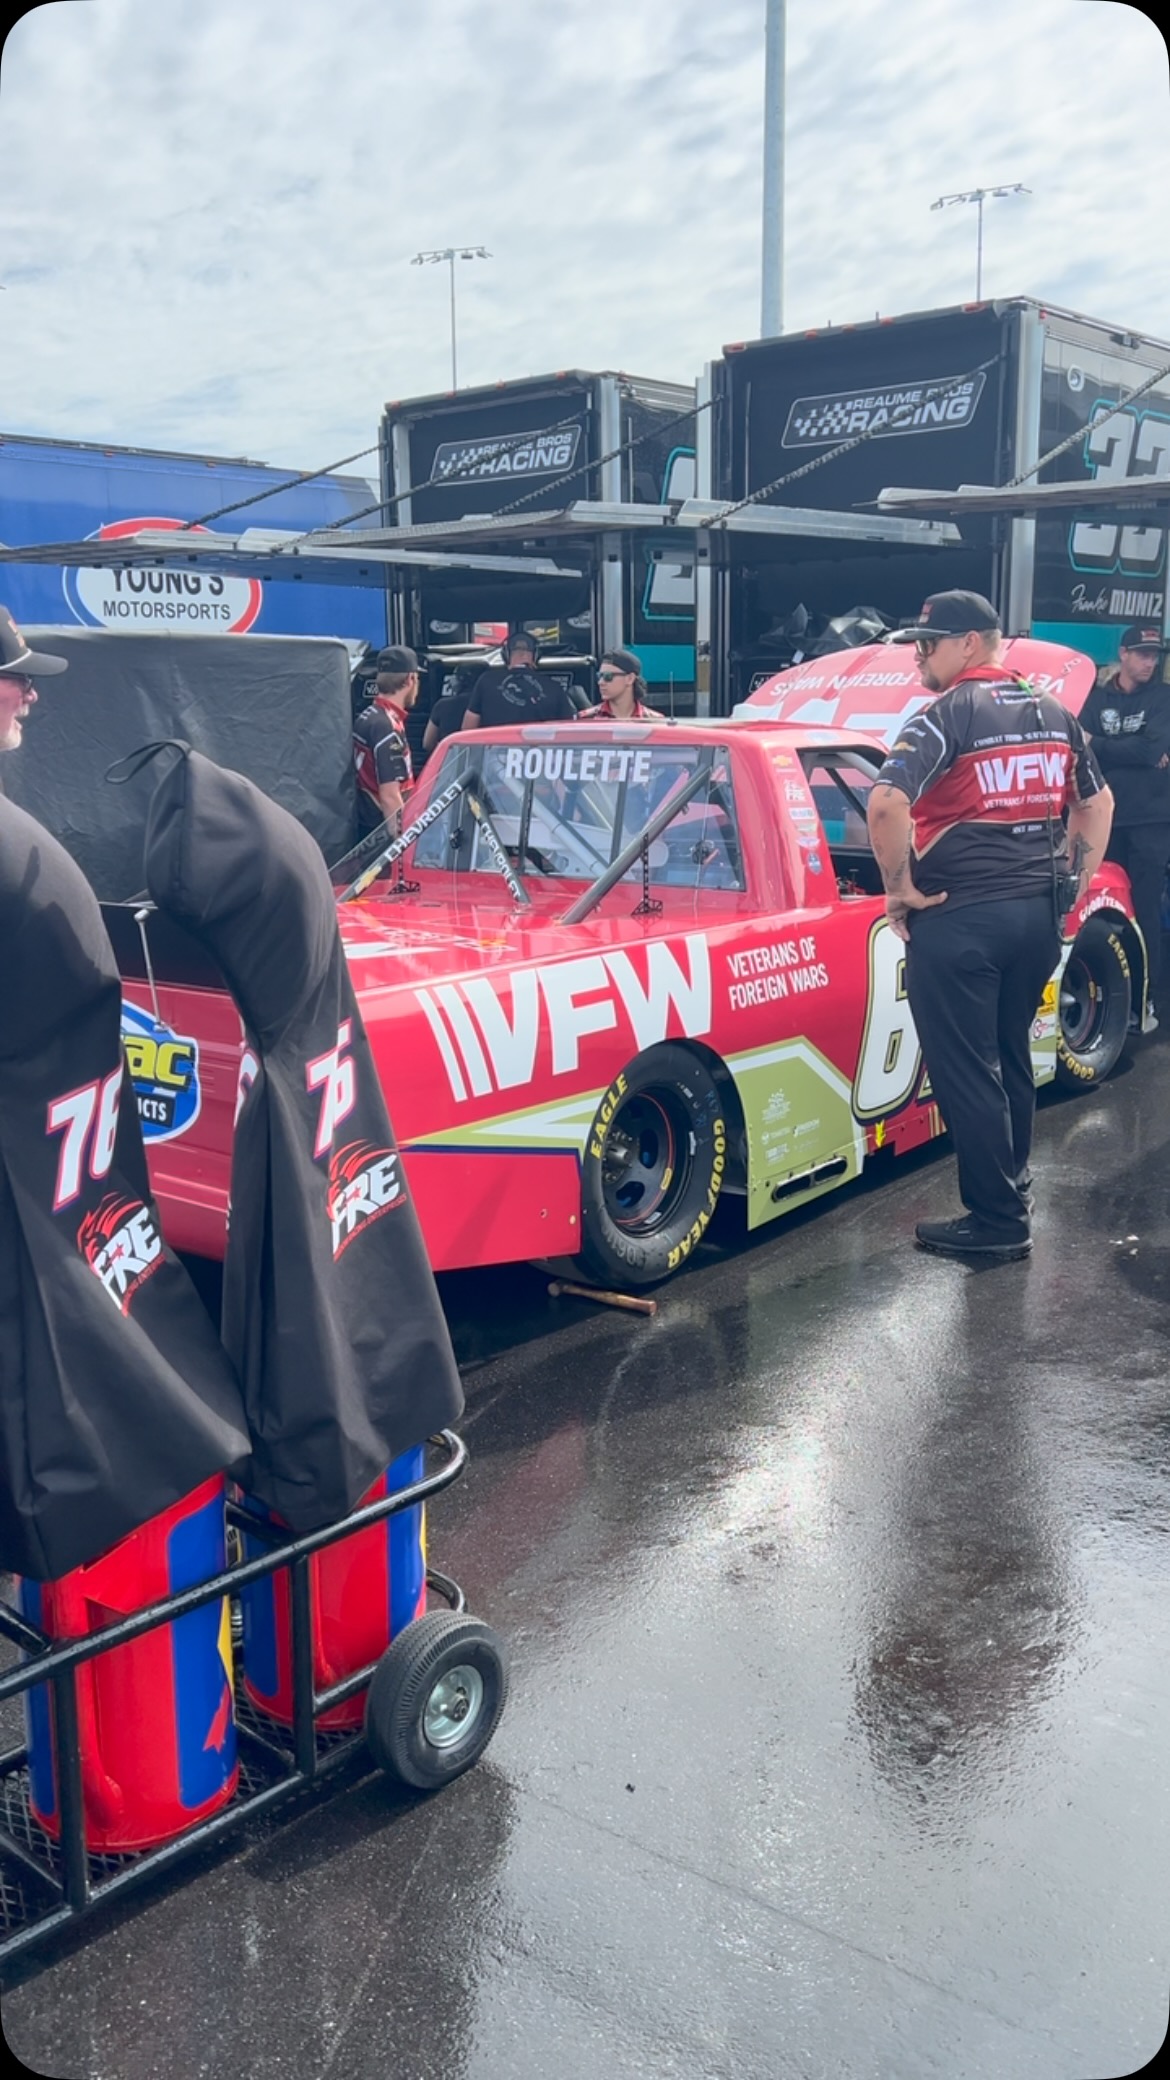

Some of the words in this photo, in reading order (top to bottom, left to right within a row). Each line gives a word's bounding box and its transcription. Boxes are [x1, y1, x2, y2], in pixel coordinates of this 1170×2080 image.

[847, 396, 972, 433] RACING
[853, 390, 923, 410] REAUME
[478, 445, 571, 475] RACING
[536, 433, 574, 447] BROS
[112, 569, 224, 596] YOUNGS
[1108, 589, 1163, 617] MUNIZ
[103, 600, 231, 620] MOTORSPORTS
[505, 748, 653, 784] ROULETTE
[984, 752, 1068, 794] VFW
[385, 781, 463, 862] CHEVROLET
[726, 940, 799, 979] VETERANS
[799, 936, 817, 960] OF
[728, 973, 788, 1011] FOREIGN
[788, 964, 829, 994] WARS
[455, 932, 713, 1092] VFW
[590, 1073, 629, 1160] EAGLE
[331, 1153, 400, 1255] FRE
[667, 1118, 726, 1270] GOODYEAR
[93, 1206, 162, 1310] FRE
